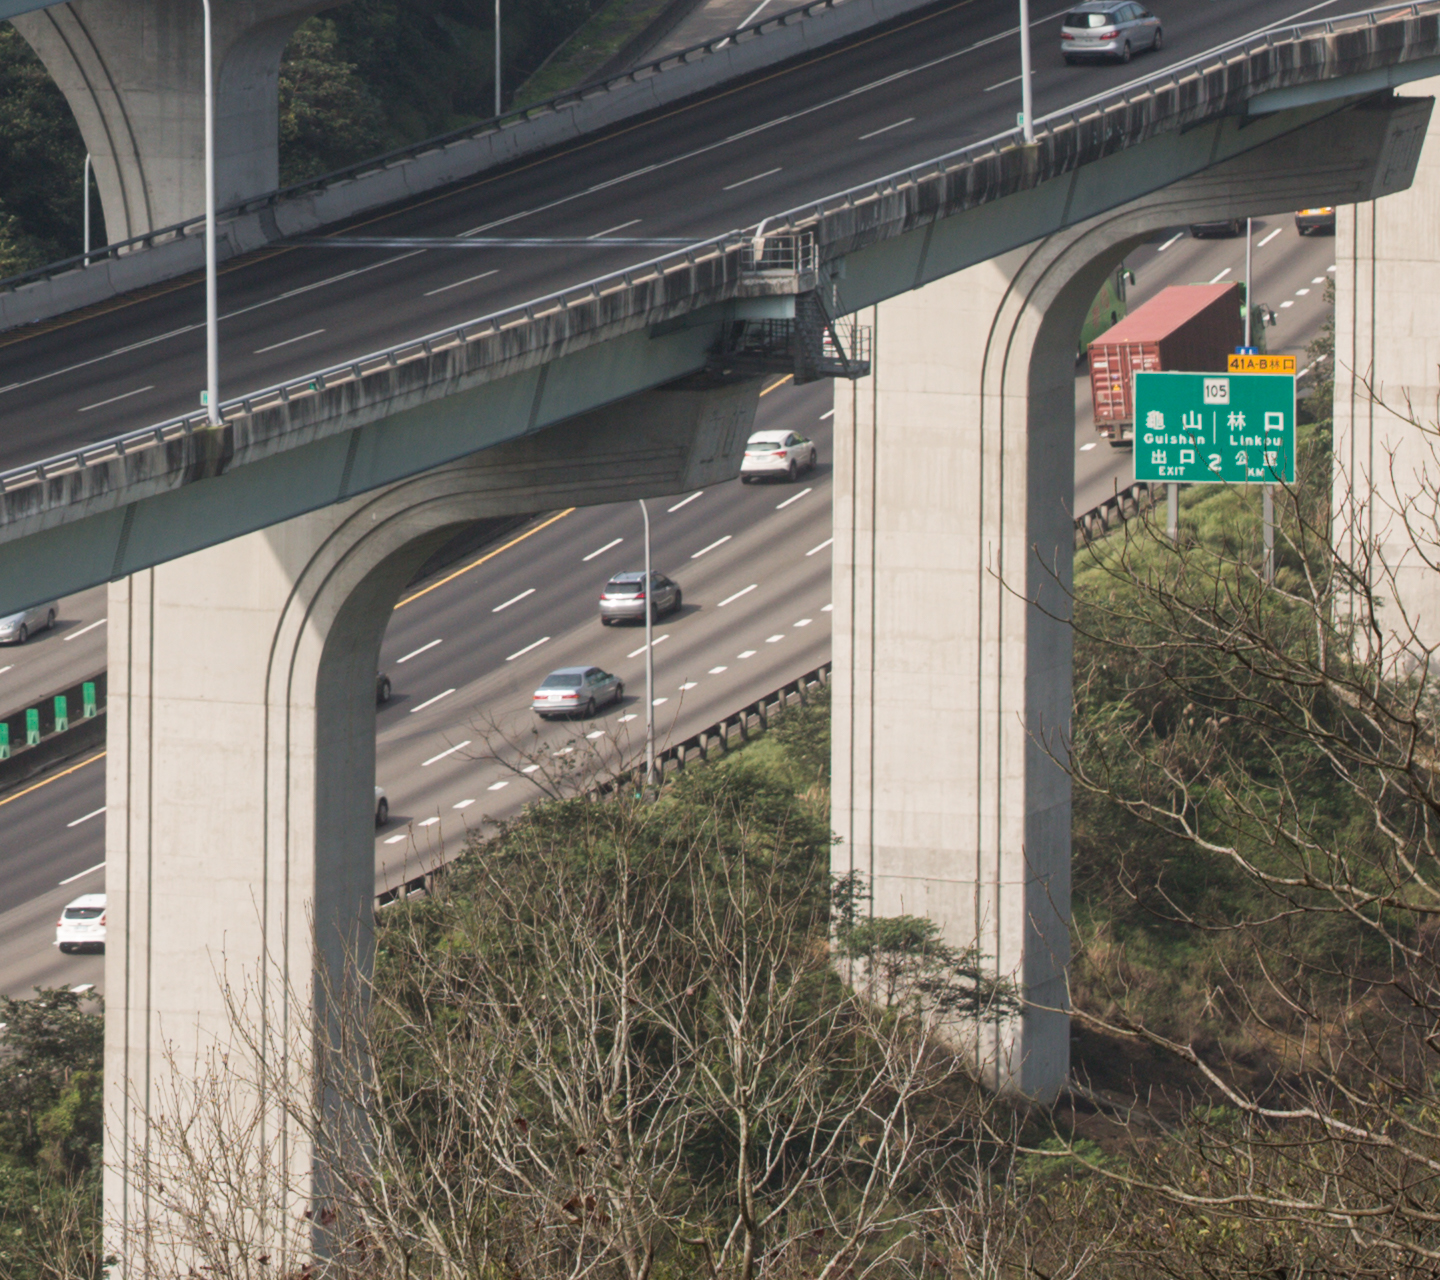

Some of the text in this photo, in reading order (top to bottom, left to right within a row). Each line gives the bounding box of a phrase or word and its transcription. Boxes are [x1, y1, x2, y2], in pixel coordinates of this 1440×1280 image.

[1229, 358, 1294, 370] 41A-B 林口
[1205, 384, 1227, 398] 105
[1226, 411, 1284, 432] 林口
[1143, 432, 1206, 445] Guishan
[1229, 434, 1283, 446] Linkou
[1151, 448, 1195, 465] 出口
[1207, 453, 1222, 472] 2
[1158, 466, 1185, 476] EXIT
[1247, 467, 1265, 478] KM
